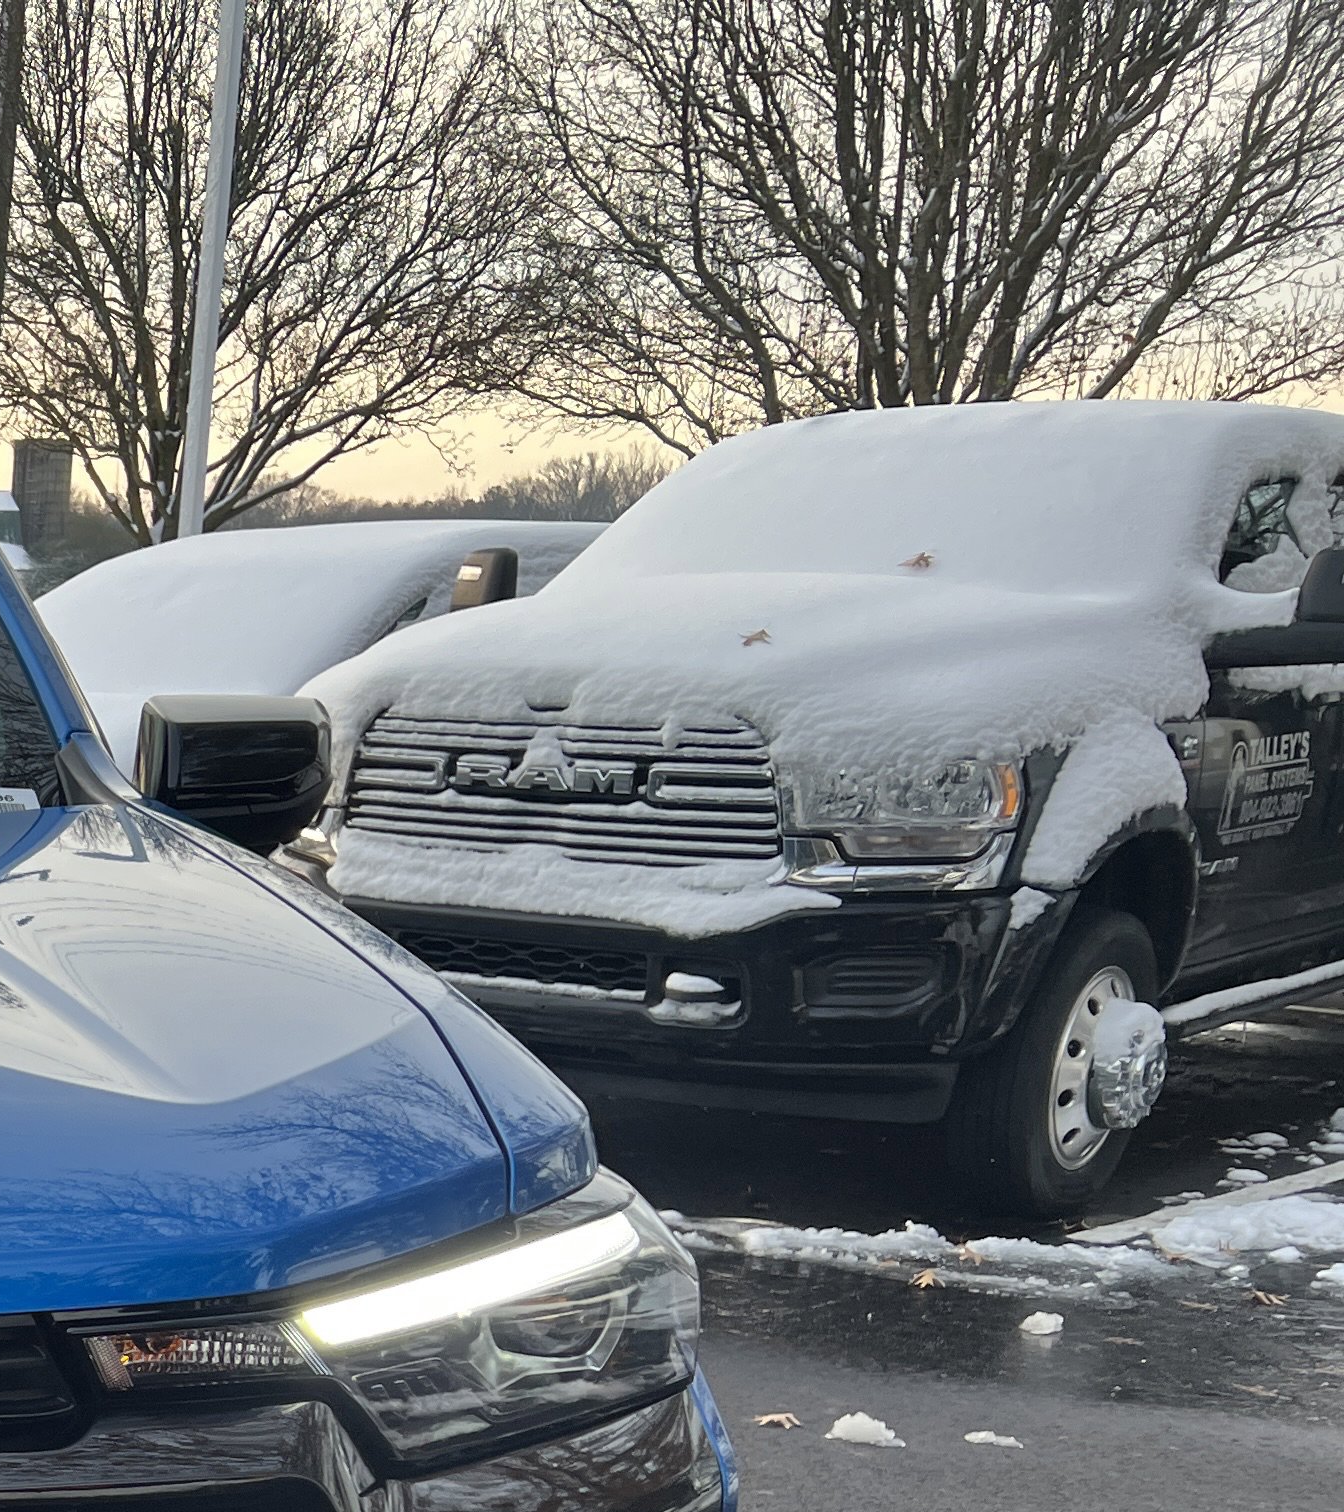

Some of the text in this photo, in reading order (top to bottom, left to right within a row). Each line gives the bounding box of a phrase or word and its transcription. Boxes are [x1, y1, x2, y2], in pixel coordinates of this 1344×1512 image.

[1250, 731, 1310, 765] TALLEY'S
[456, 761, 635, 795] RAM
[1244, 771, 1269, 793] PANEL
